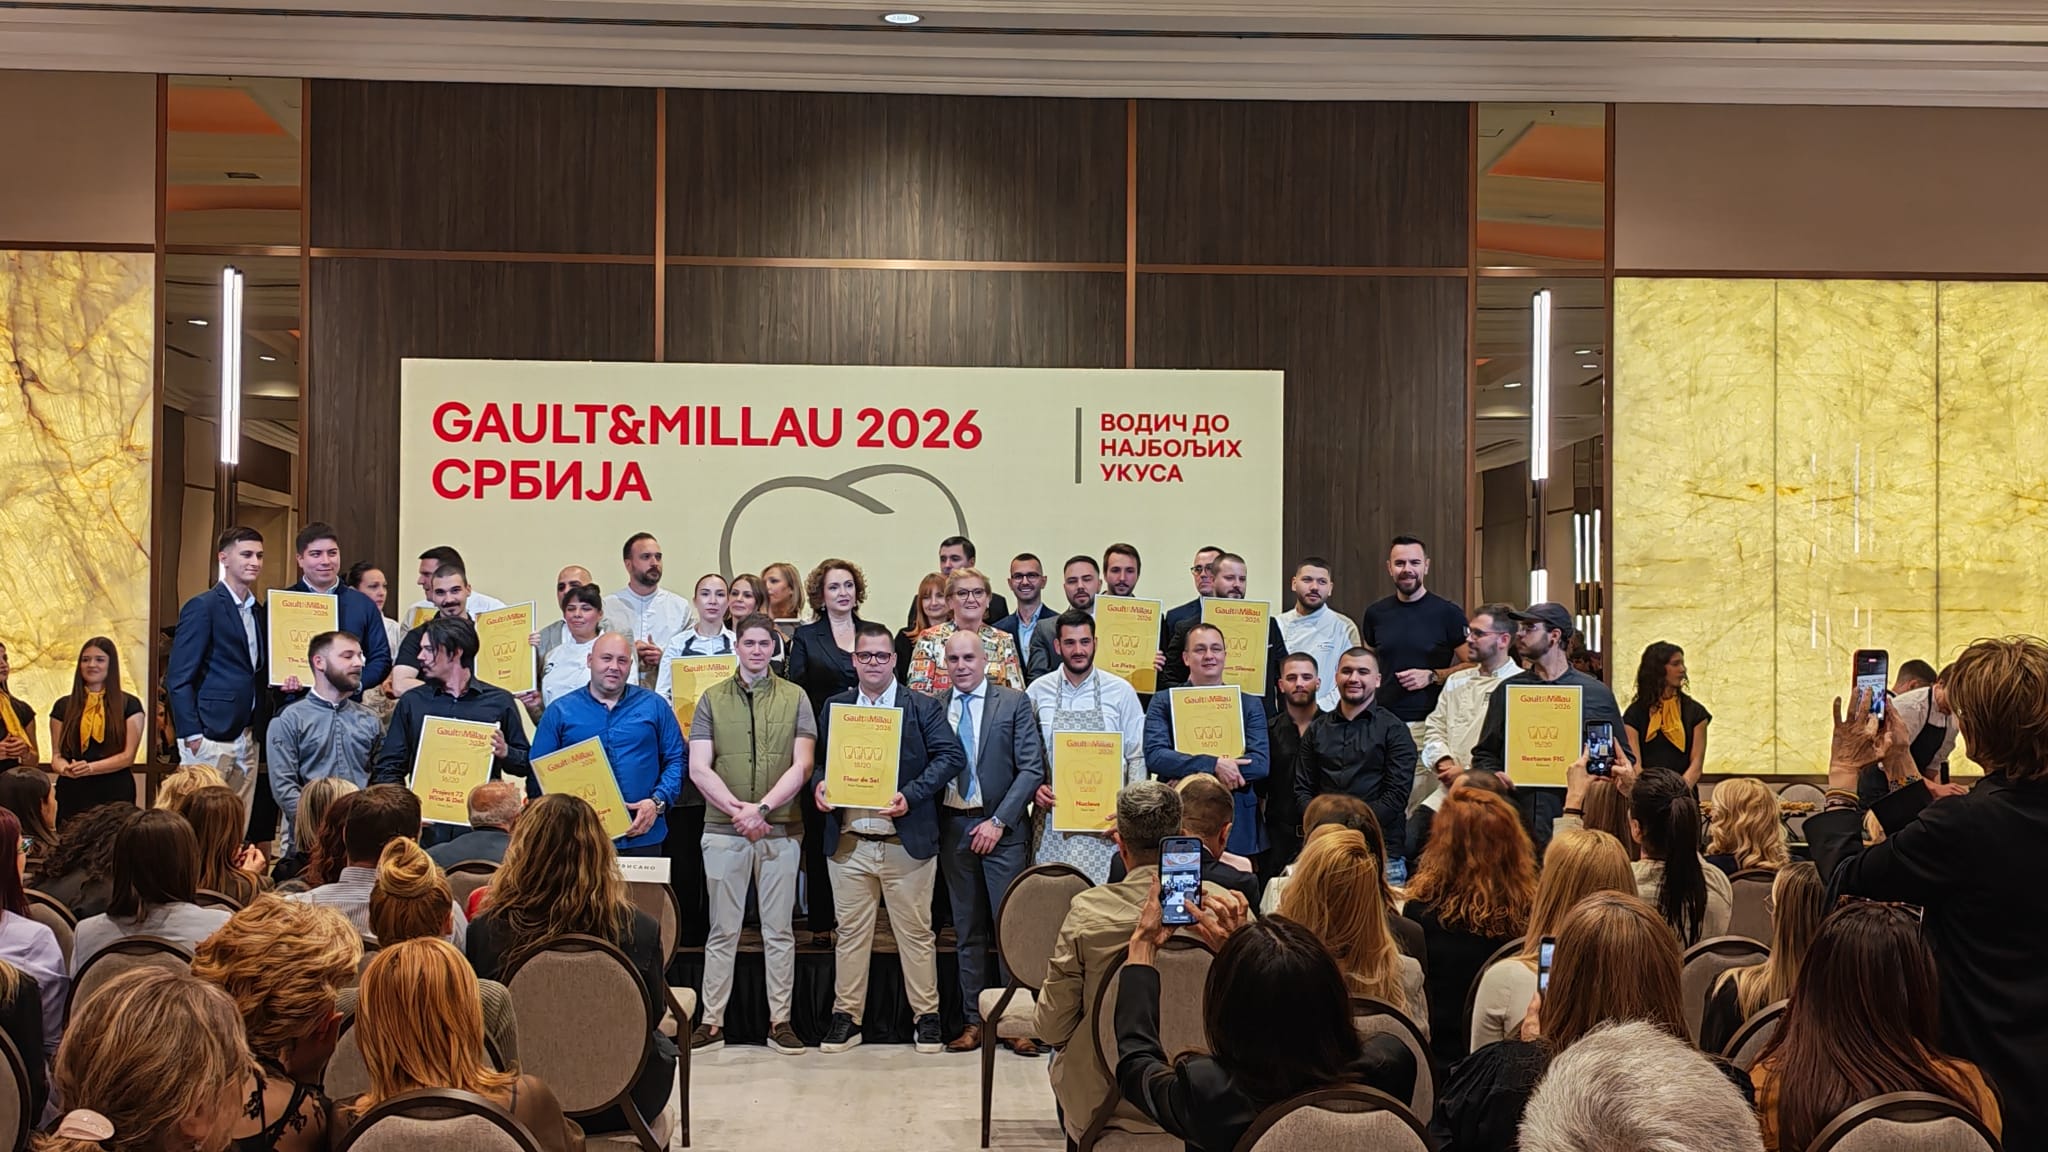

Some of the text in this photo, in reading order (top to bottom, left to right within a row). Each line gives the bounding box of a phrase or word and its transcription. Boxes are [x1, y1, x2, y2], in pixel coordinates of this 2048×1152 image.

[432, 402, 983, 449] GAULT&MILLAU 2026
[1101, 413, 1230, 436] ВОДИЧ ДО
[1101, 438, 1243, 458] НАЈБОЉИХ
[432, 459, 653, 502] СРБИЈА
[1100, 463, 1184, 482] УКУСА
